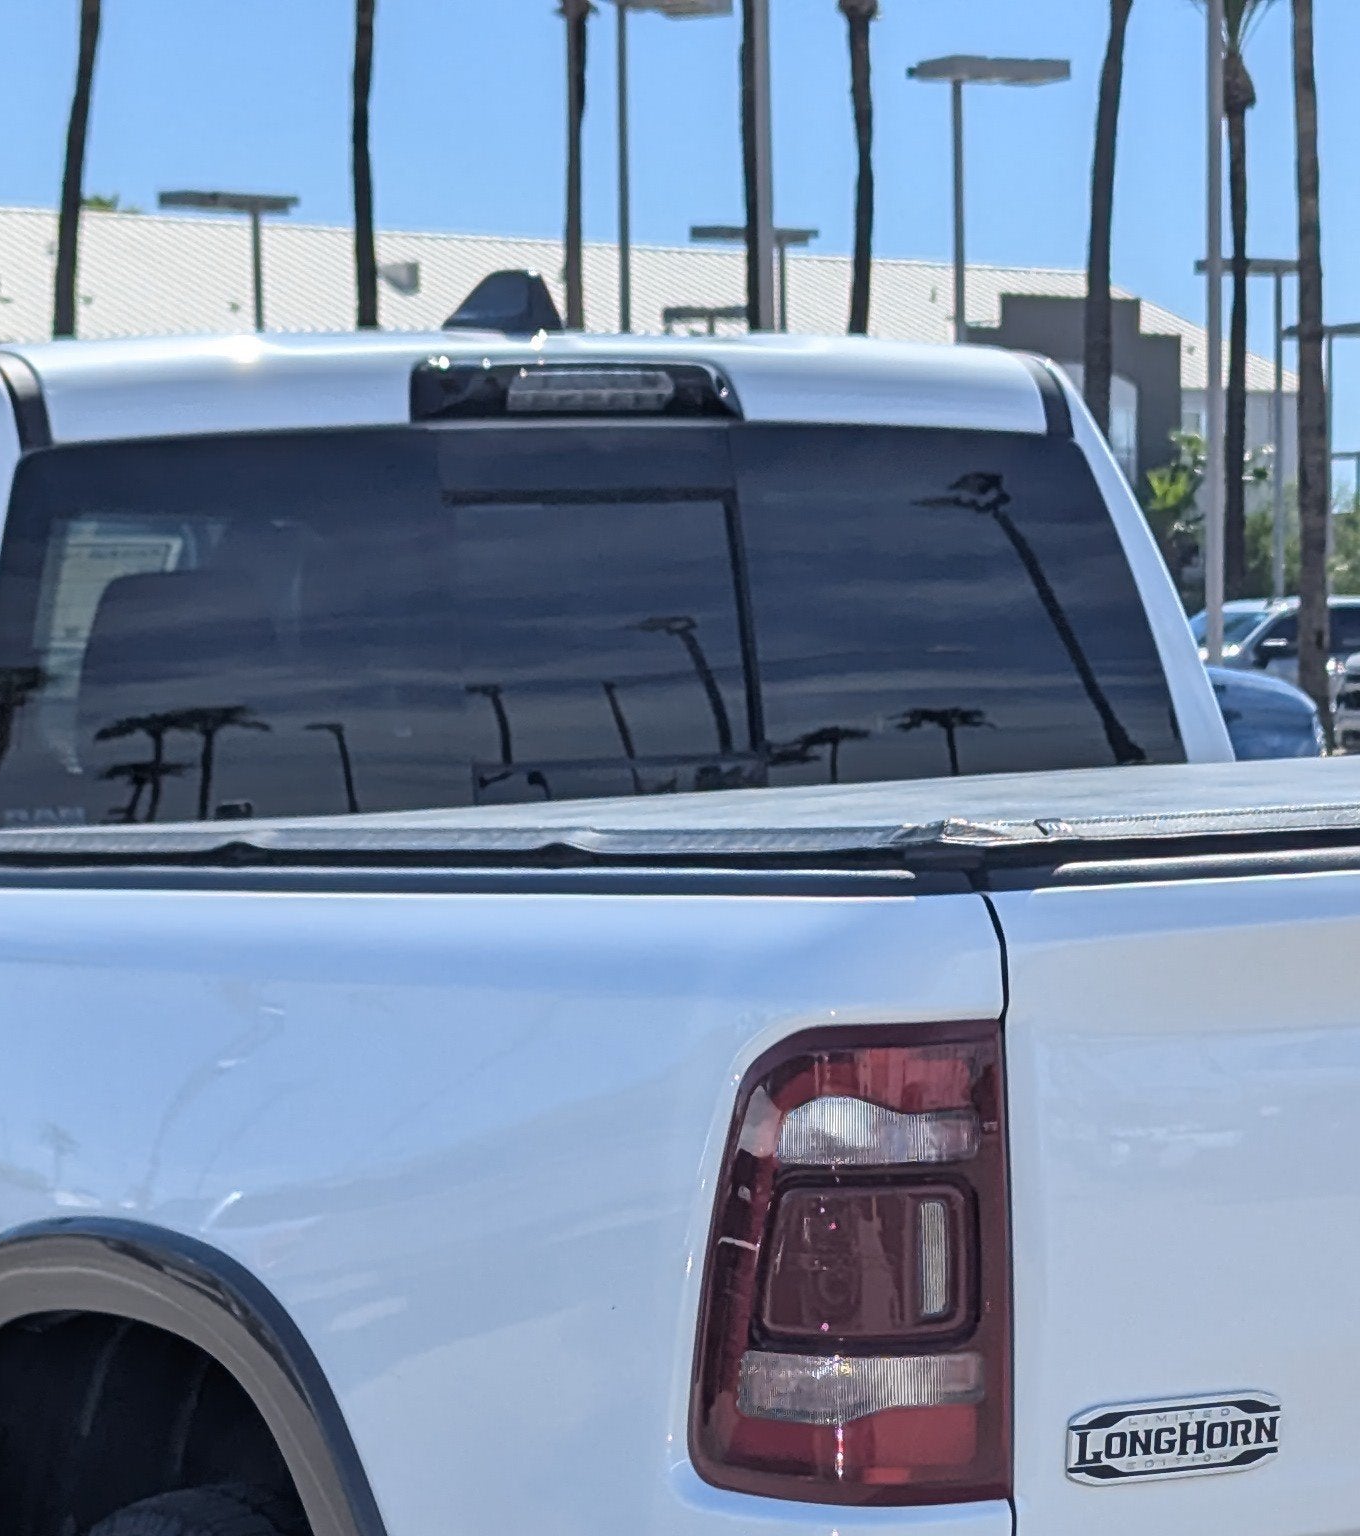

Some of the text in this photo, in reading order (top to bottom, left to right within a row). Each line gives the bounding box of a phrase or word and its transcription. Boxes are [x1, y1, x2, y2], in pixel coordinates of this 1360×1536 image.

[1128, 1407, 1231, 1427] LIMITED
[1074, 1416, 1281, 1466] LONGHORN
[1125, 1453, 1229, 1470] EDITION
